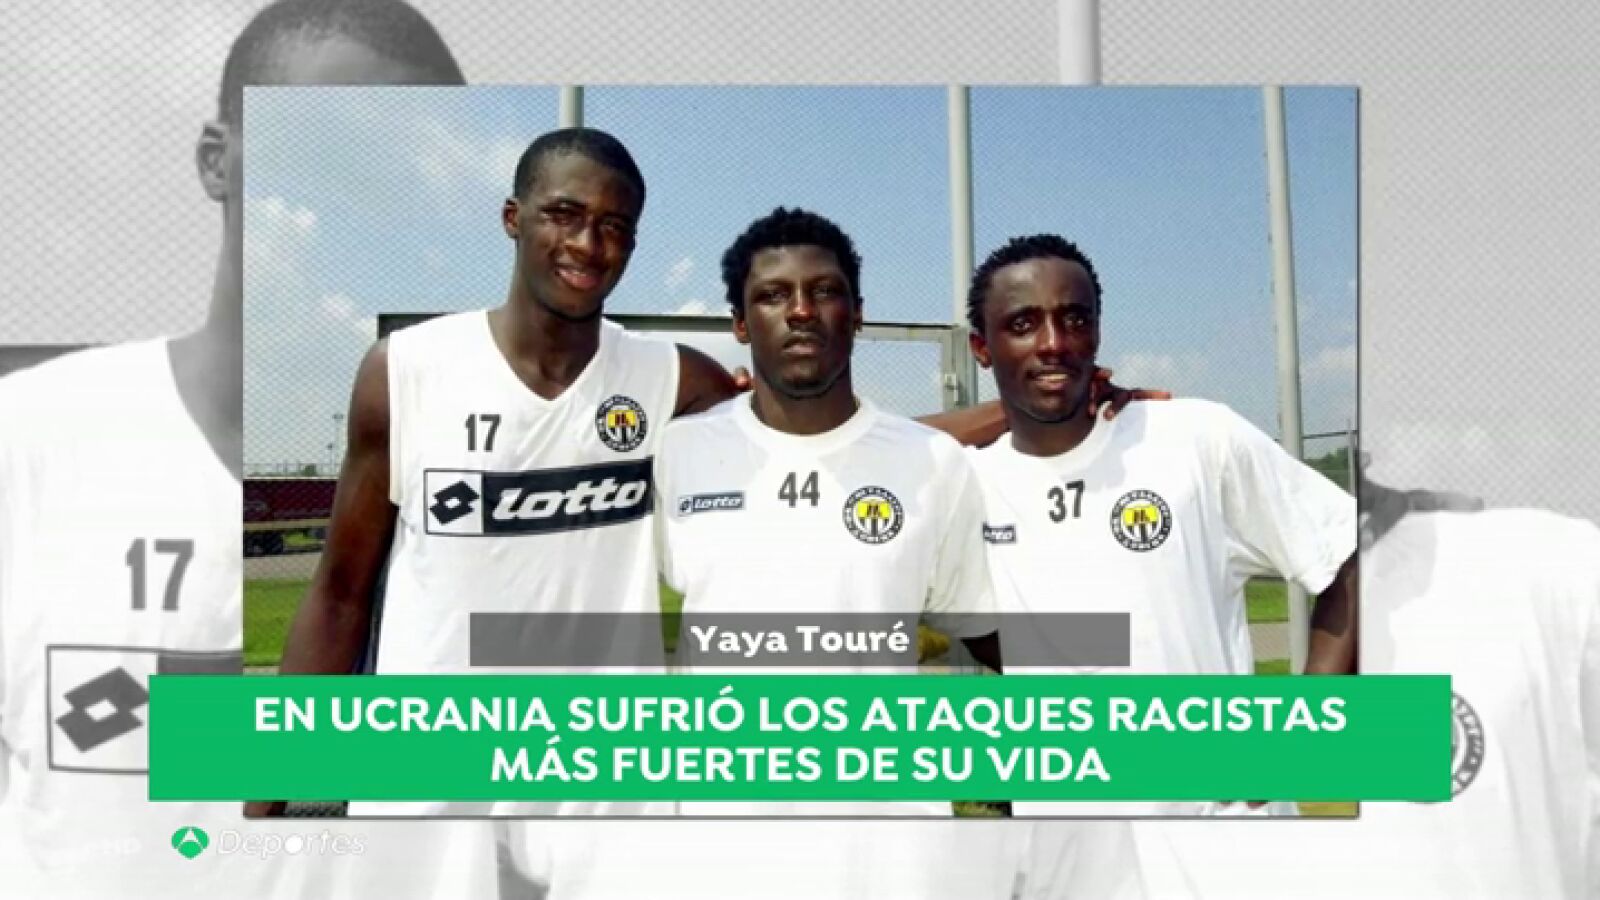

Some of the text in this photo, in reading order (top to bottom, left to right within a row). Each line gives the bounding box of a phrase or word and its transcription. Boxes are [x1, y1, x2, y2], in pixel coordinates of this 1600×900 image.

[465, 413, 501, 452] 17
[778, 471, 820, 508] 44
[1047, 480, 1084, 522] 37
[125, 538, 194, 611] 17
